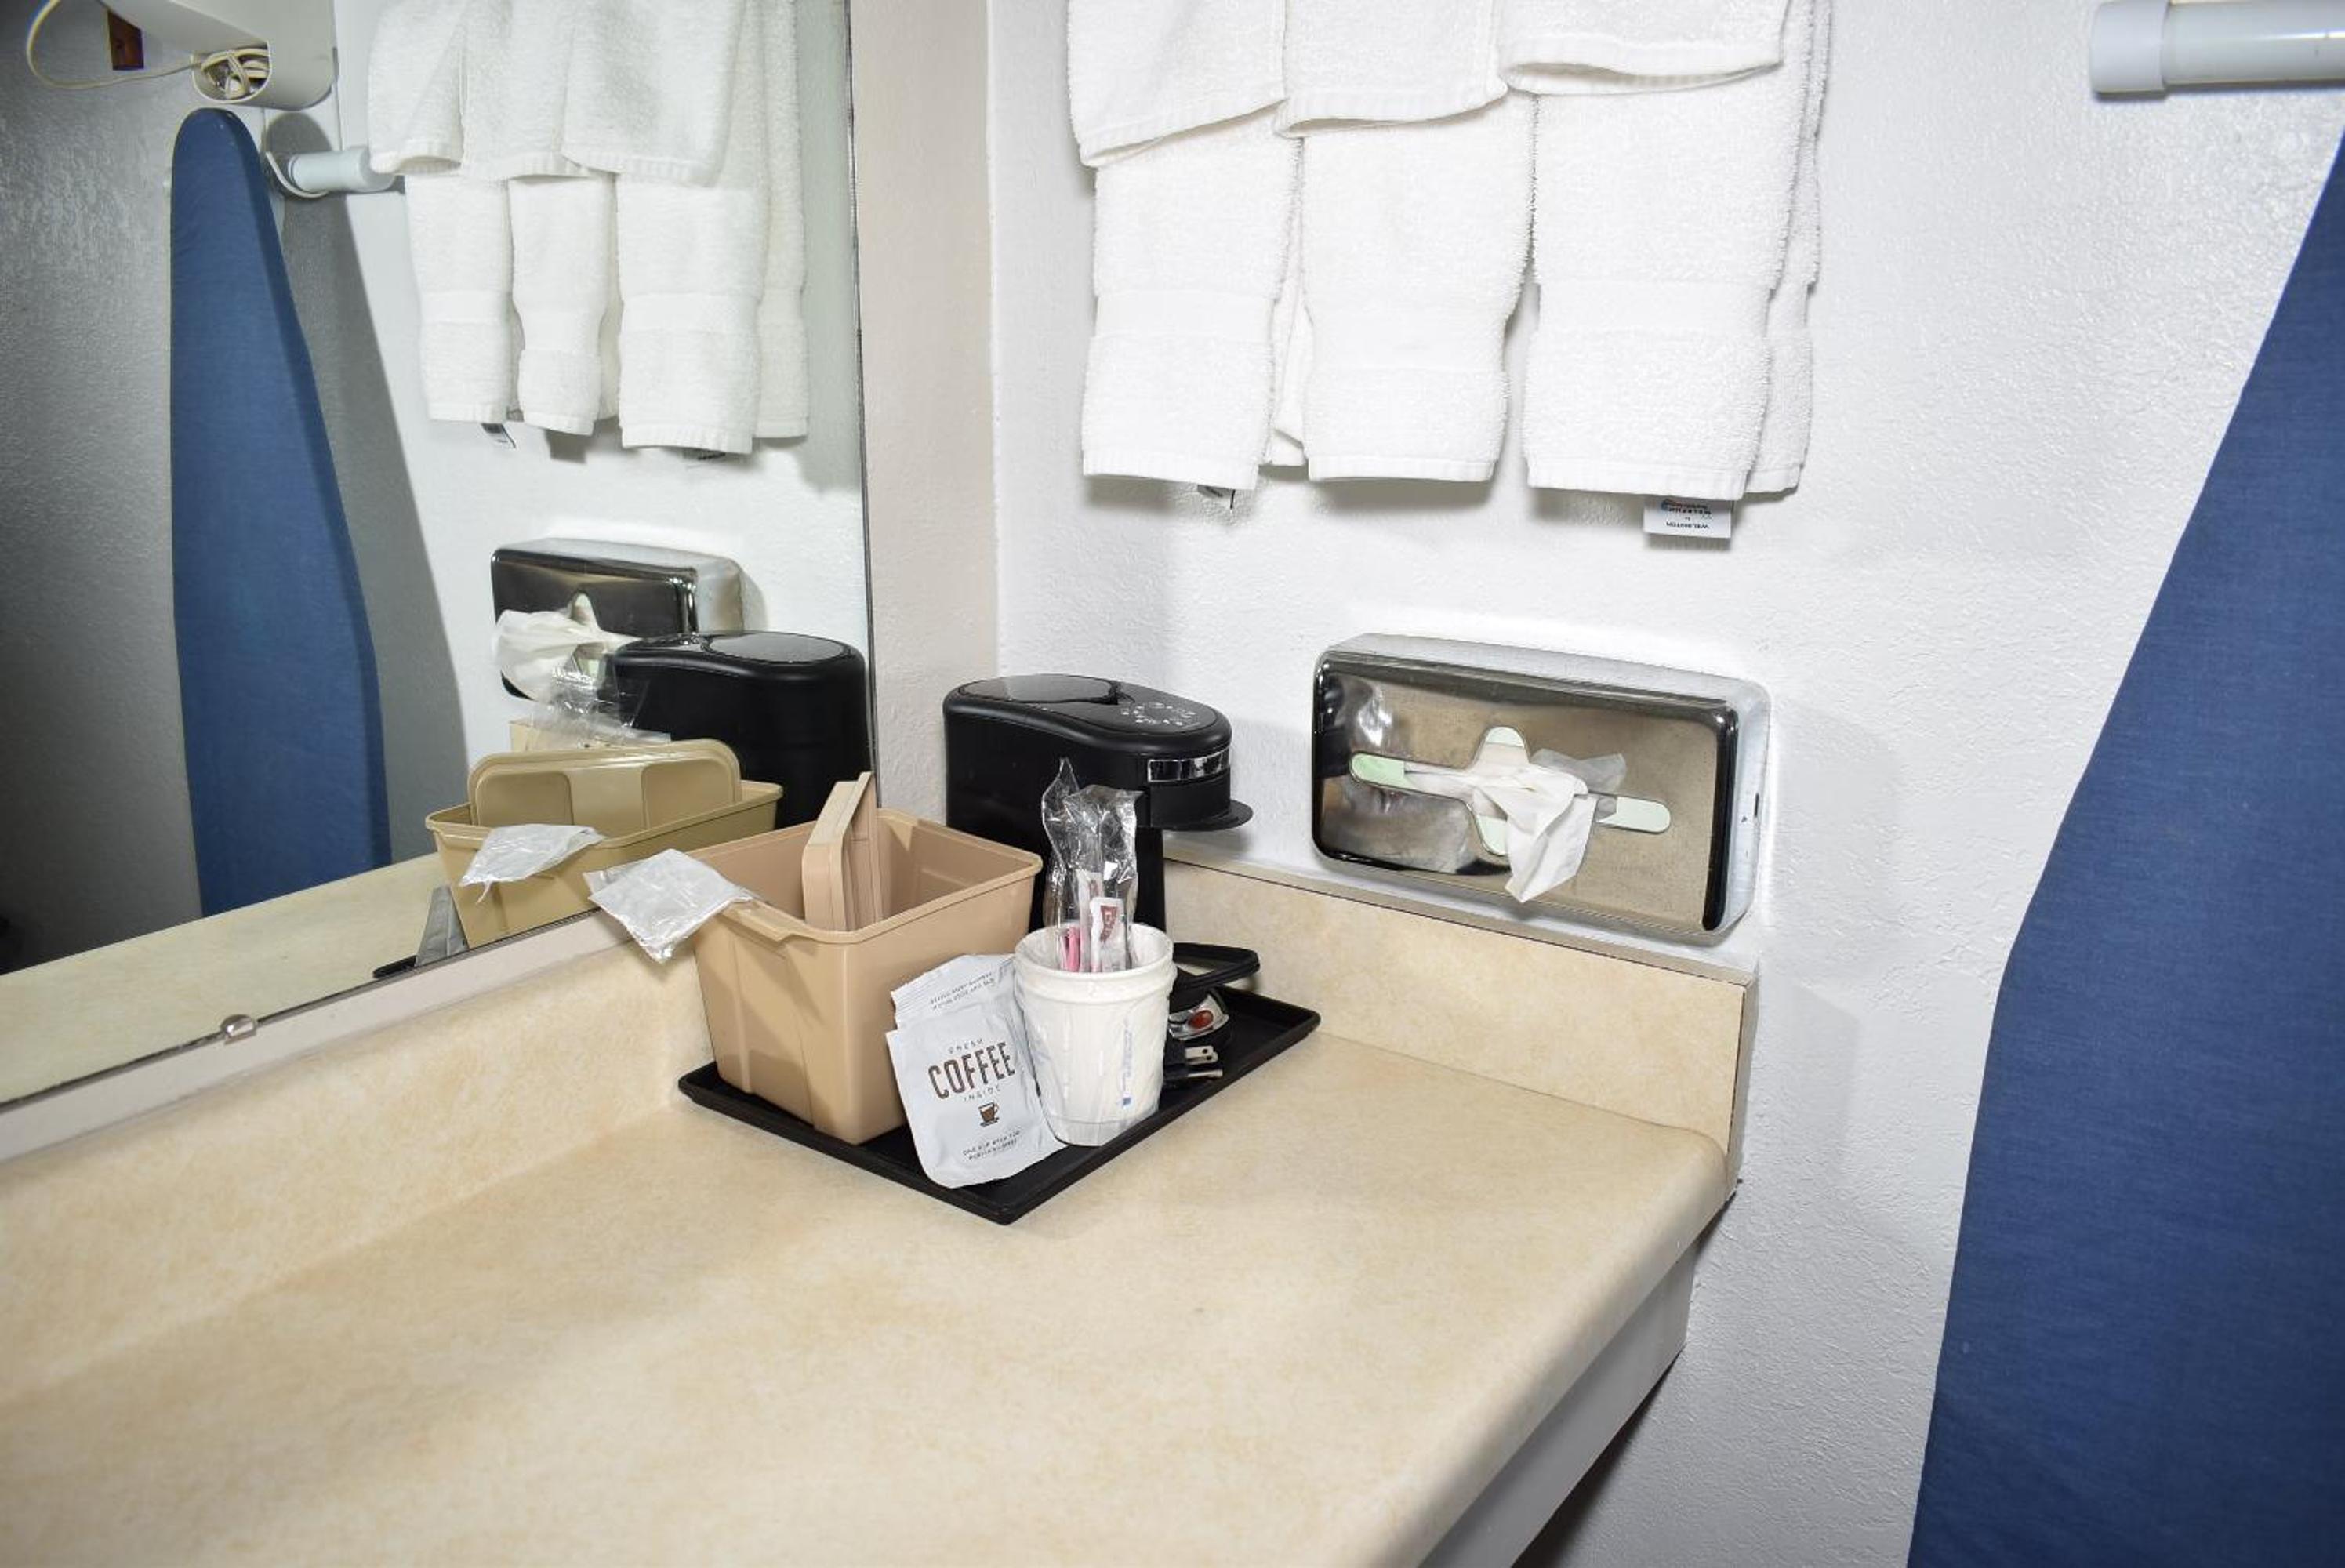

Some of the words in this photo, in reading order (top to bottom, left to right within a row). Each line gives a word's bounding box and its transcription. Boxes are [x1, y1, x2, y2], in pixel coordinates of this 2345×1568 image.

[948, 1038, 983, 1054] FRESH
[927, 1042, 1015, 1099] COFFEE
[964, 1084, 1001, 1102] INSIDE
